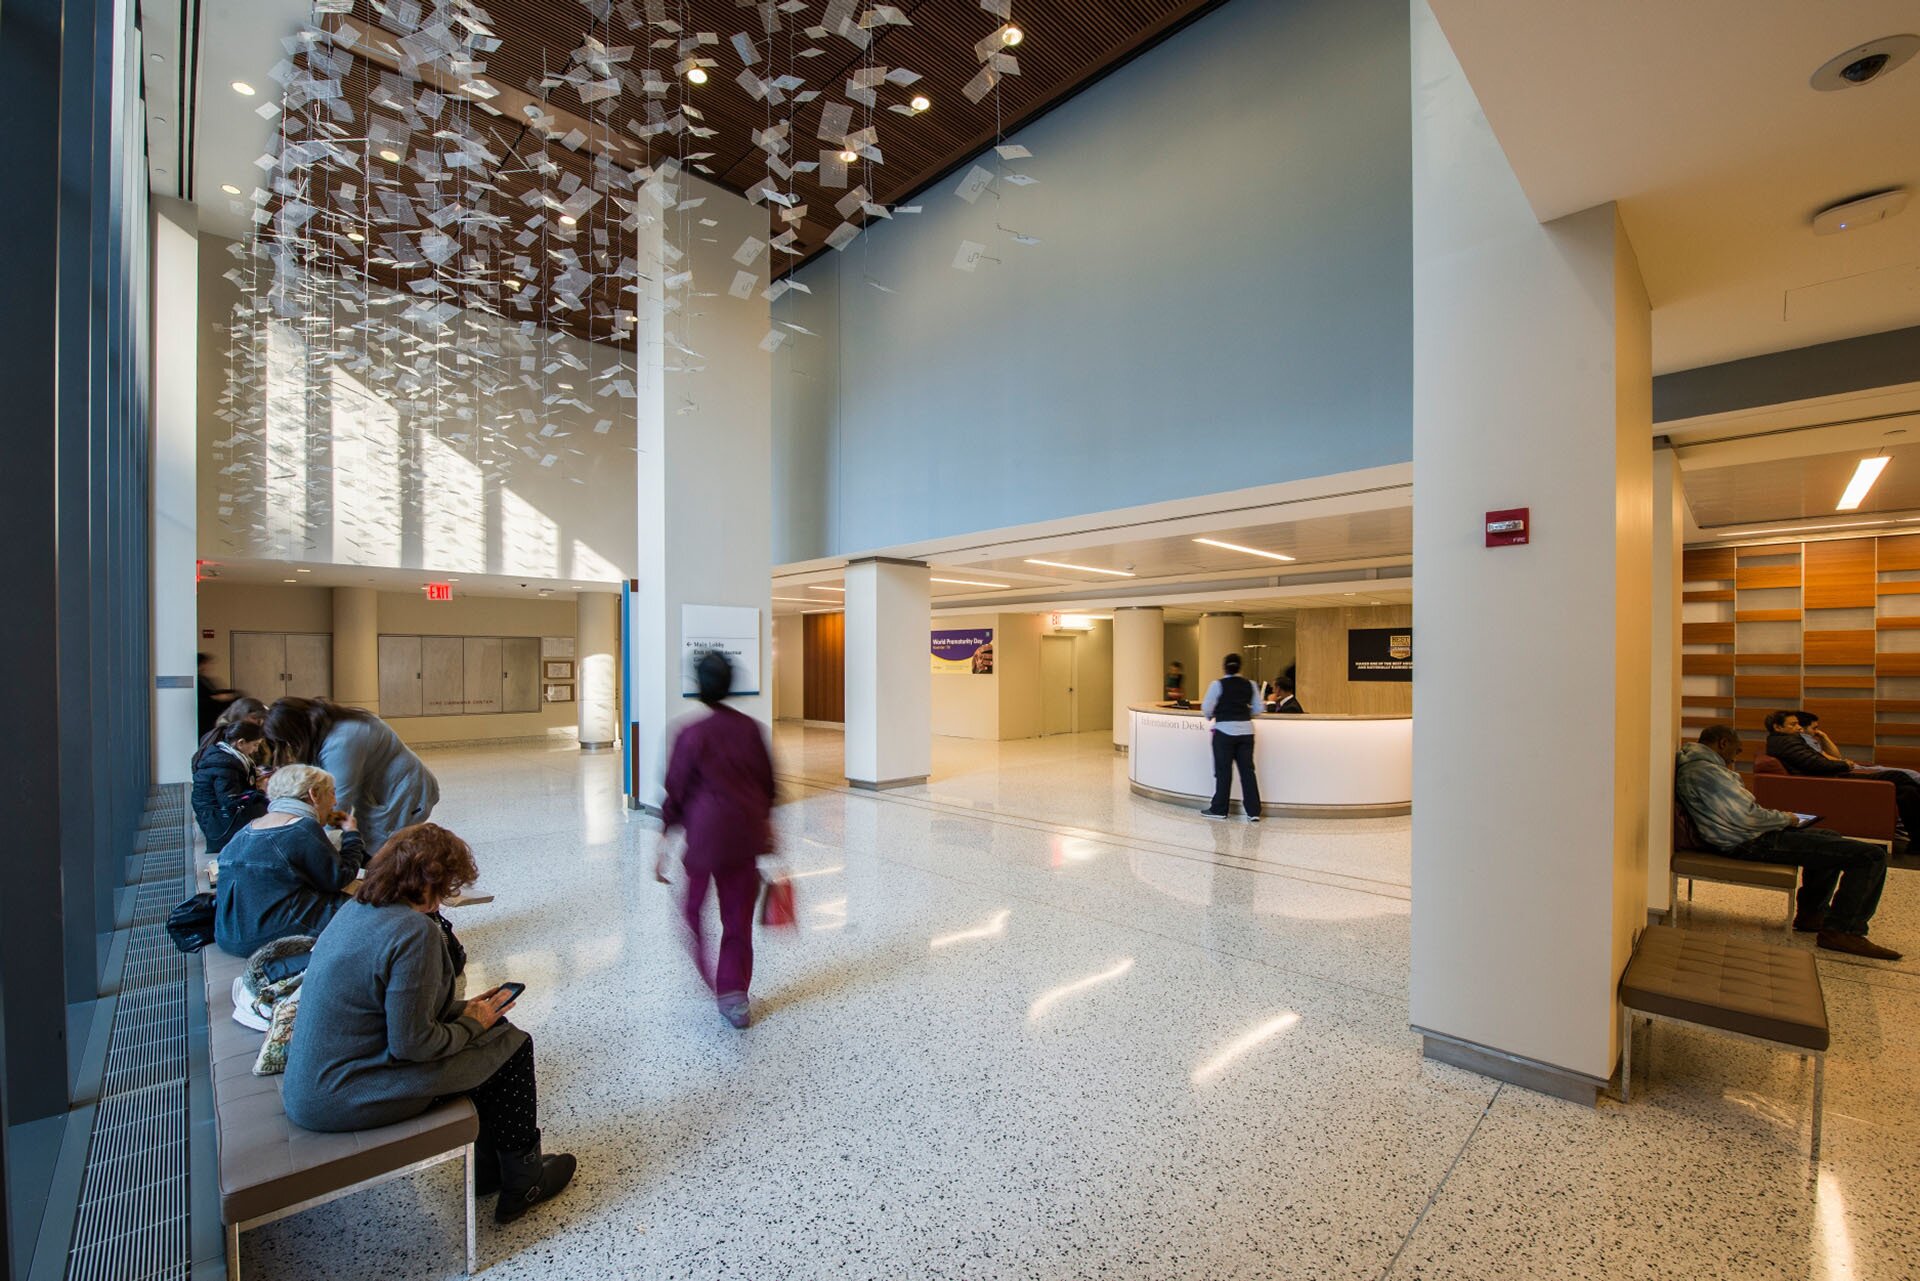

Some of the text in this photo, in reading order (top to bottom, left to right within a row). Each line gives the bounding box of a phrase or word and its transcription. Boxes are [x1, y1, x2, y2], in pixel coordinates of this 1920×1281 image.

[429, 584, 449, 600] EXIT
[946, 638, 973, 646] Prematurity
[973, 637, 983, 645] Day
[1142, 716, 1205, 731] Information Desk
